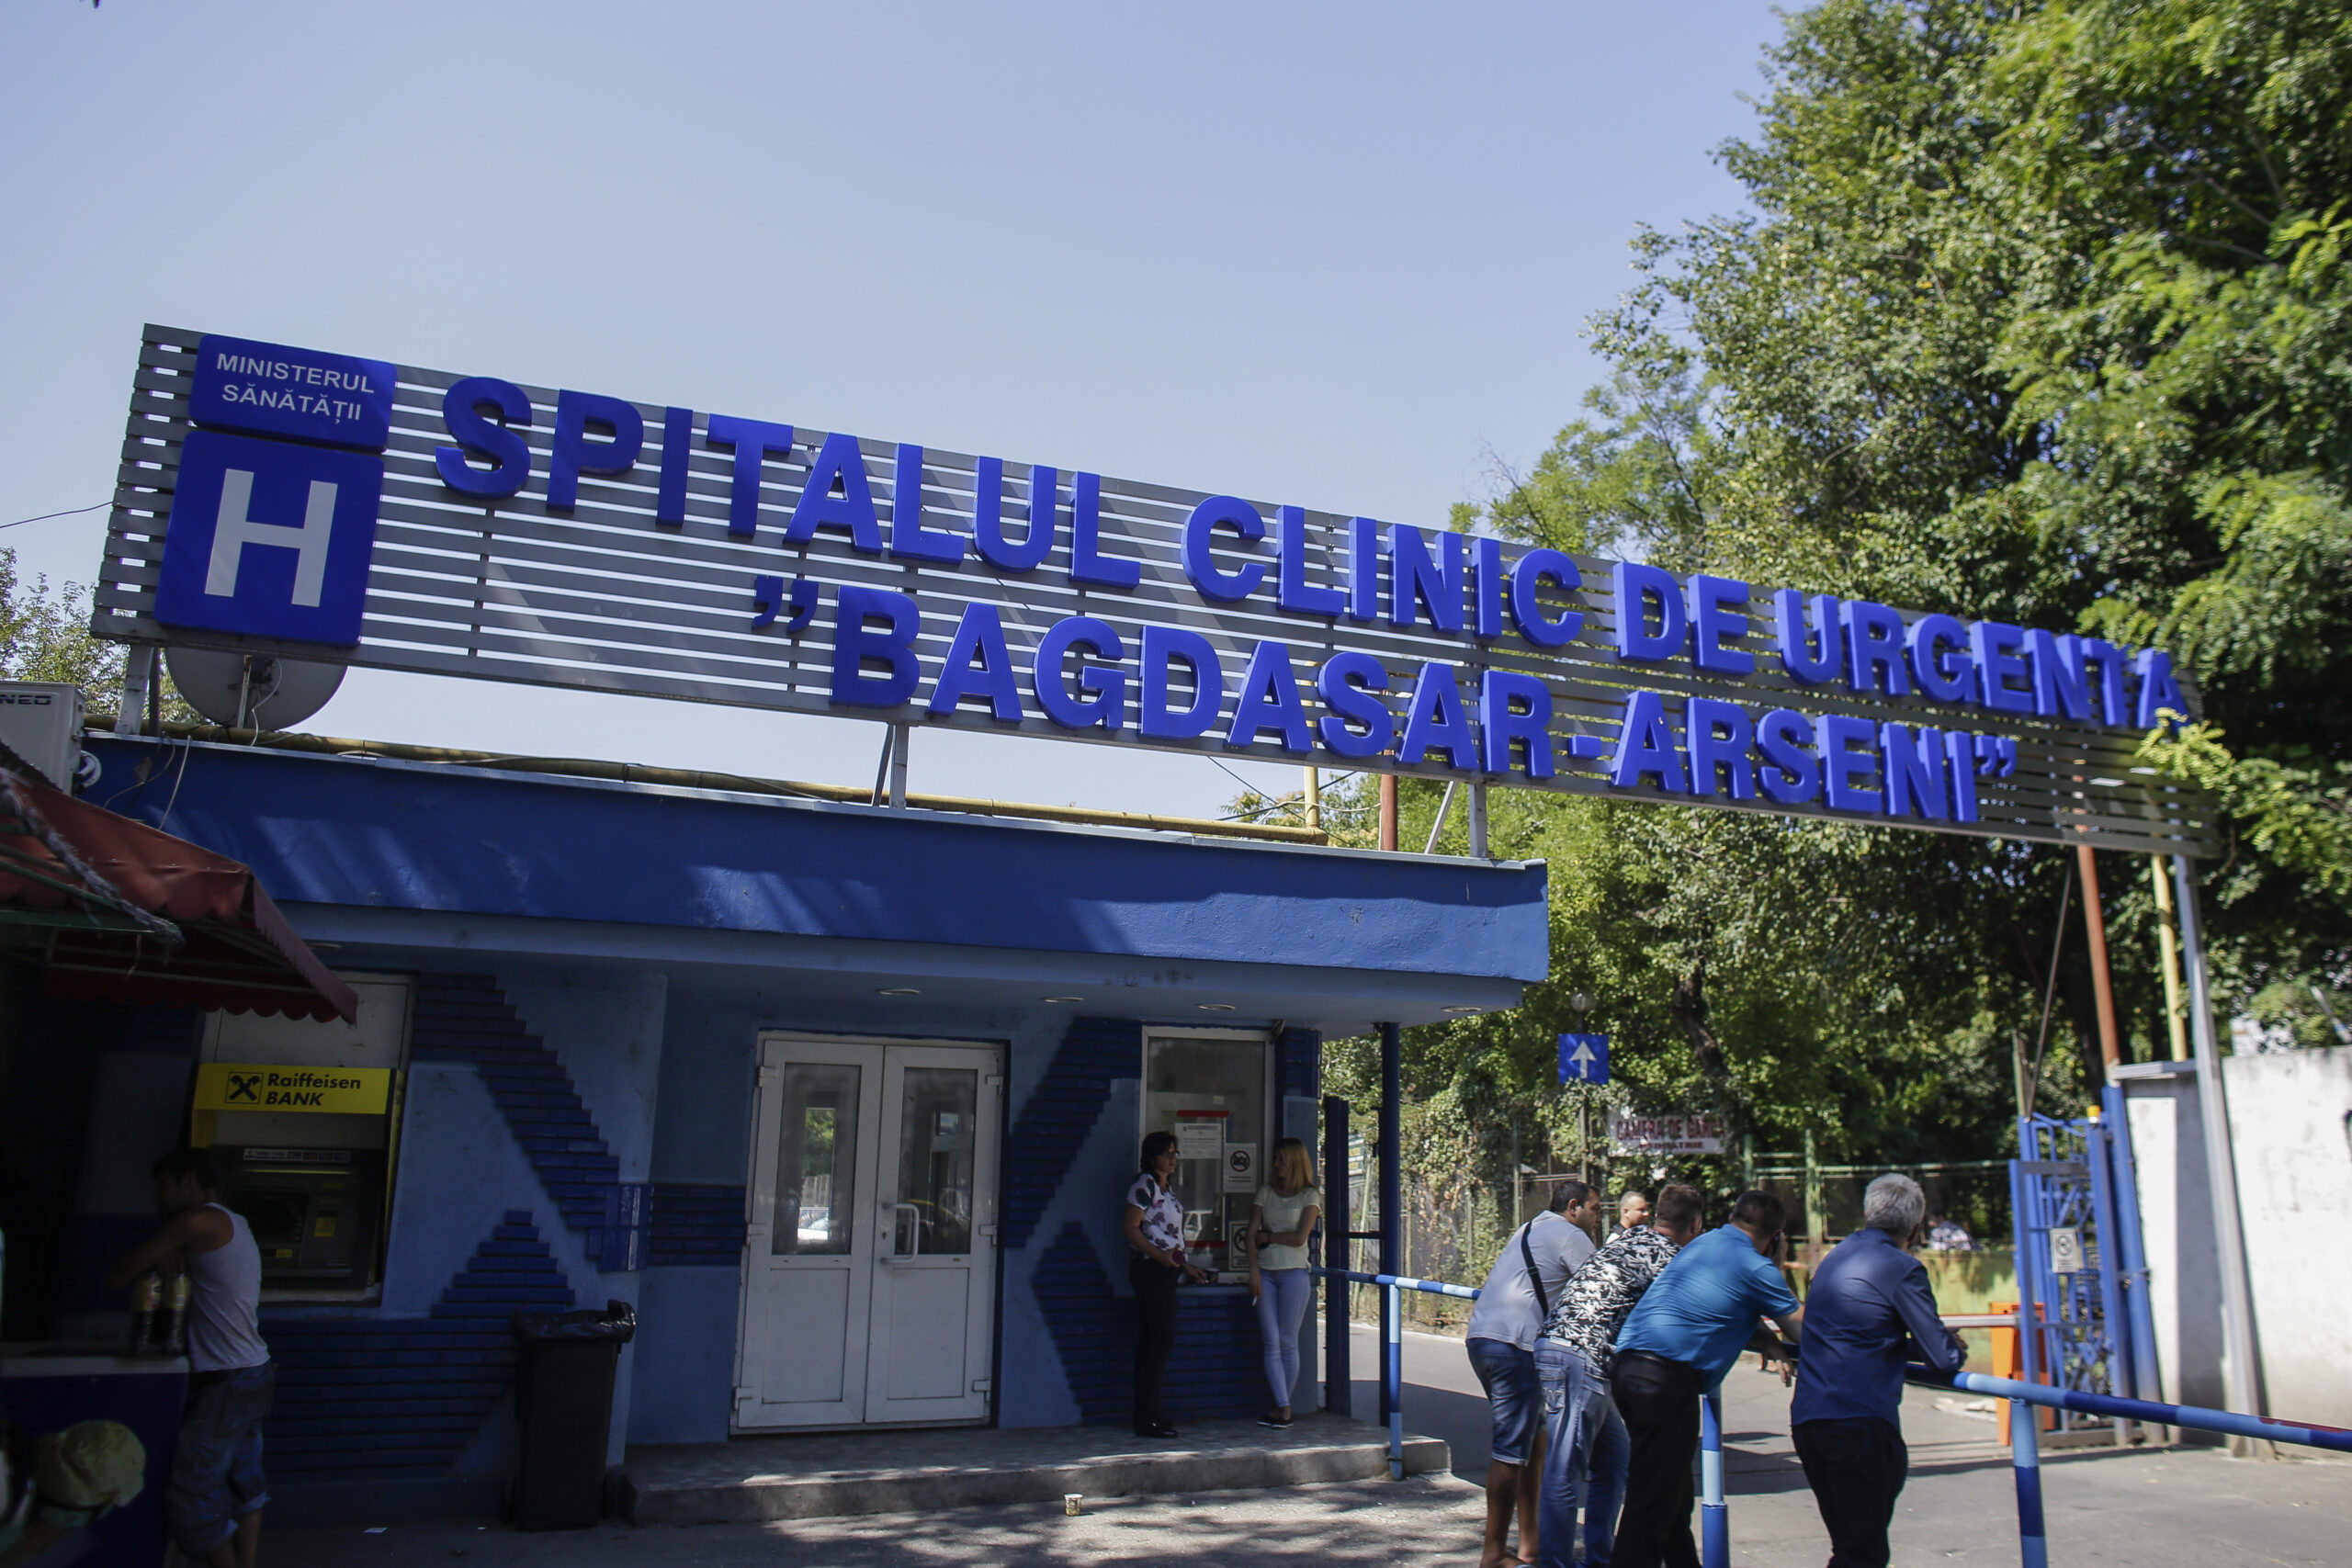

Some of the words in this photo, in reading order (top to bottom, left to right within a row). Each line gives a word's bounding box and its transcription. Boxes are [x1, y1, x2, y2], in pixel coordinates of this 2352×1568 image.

[216, 353, 375, 394] MINISTERUL
[204, 468, 339, 608] H
[435, 376, 1141, 591] SPITALUL
[1181, 495, 1584, 648] CLINIC
[1611, 560, 1755, 676] DE
[1773, 588, 2192, 736] URGENTA
[266, 1090, 324, 1106] BANK
[267, 1072, 361, 1089] Raiffeisen
